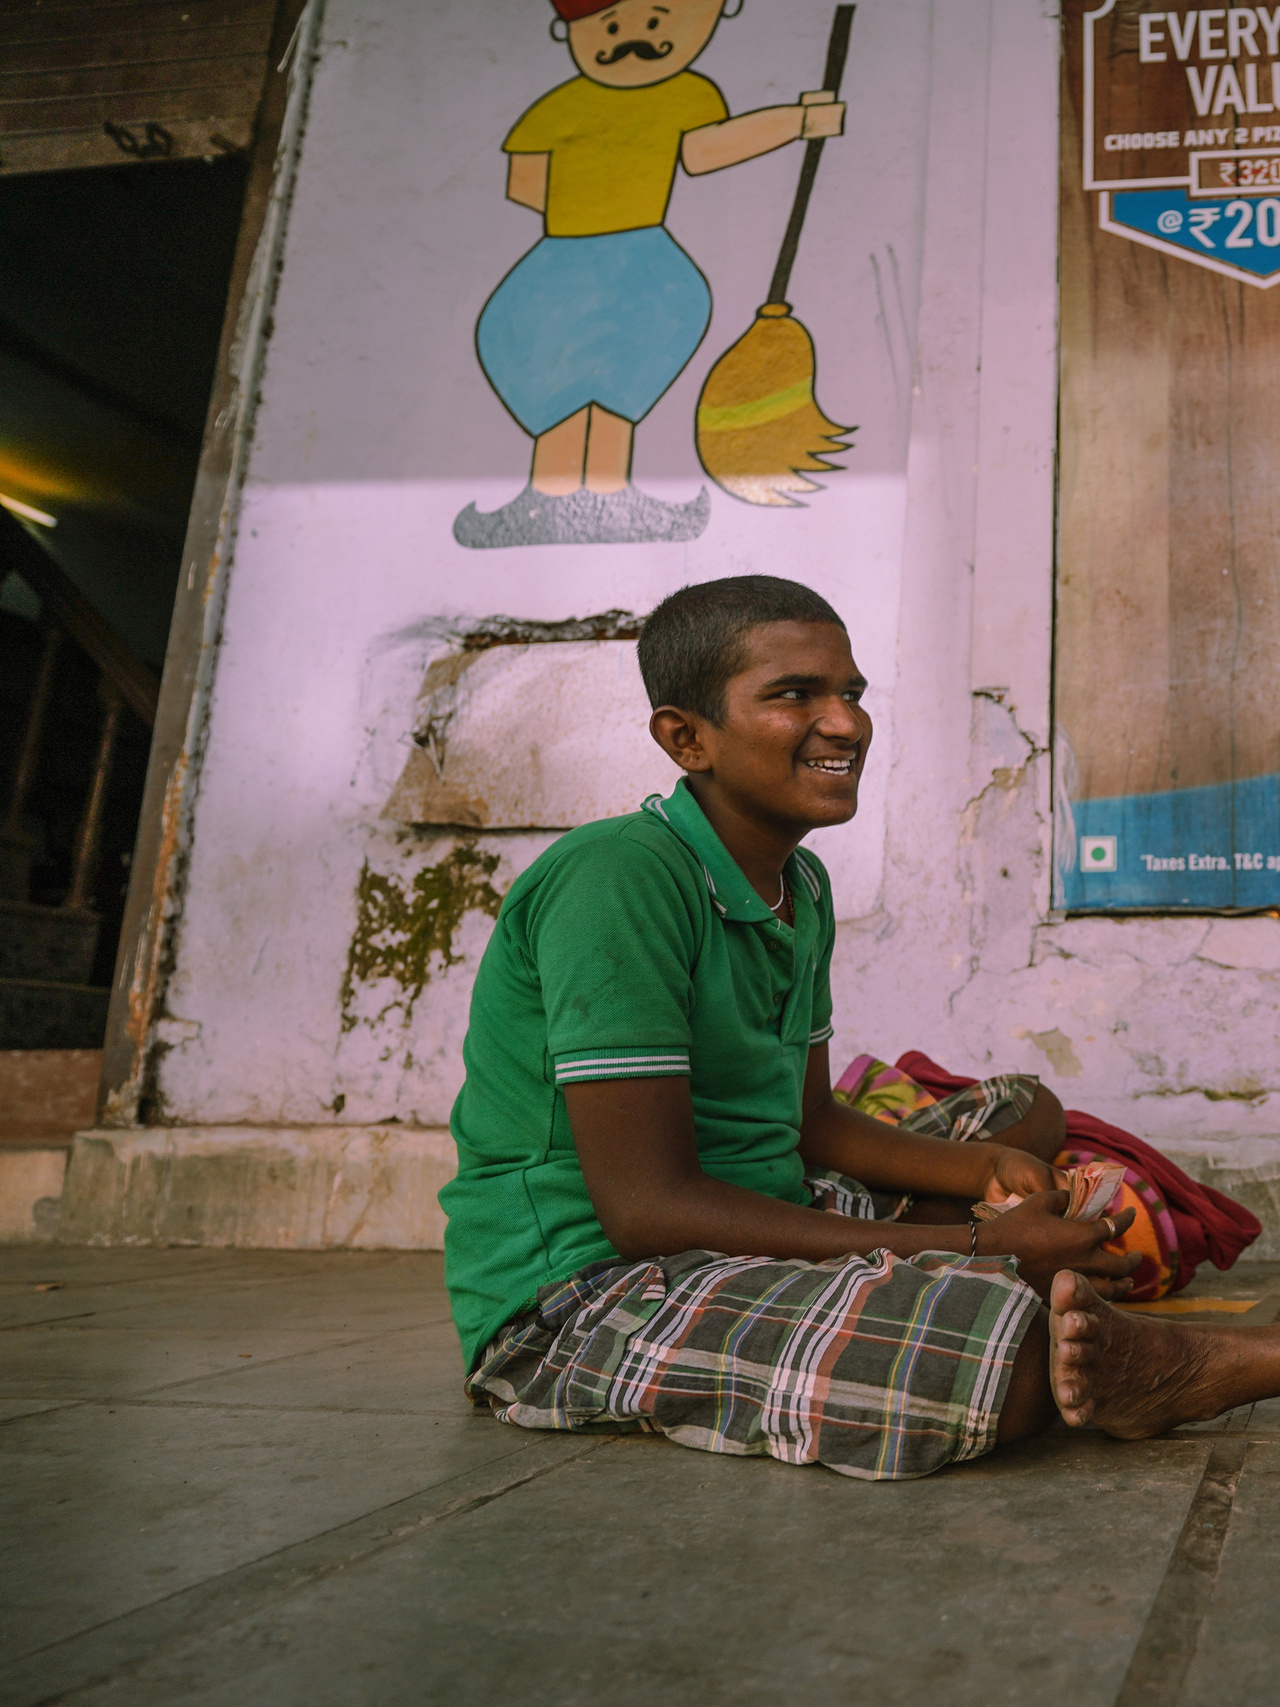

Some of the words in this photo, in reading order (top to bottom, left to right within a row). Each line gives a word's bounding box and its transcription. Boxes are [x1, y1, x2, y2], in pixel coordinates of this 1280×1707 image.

[1104, 131, 1180, 151] CHOOSE
[1183, 128, 1230, 147] ANY
[1234, 127, 1249, 144] 2
[1188, 853, 1231, 871] Extra.
[1233, 852, 1264, 870] T&C
